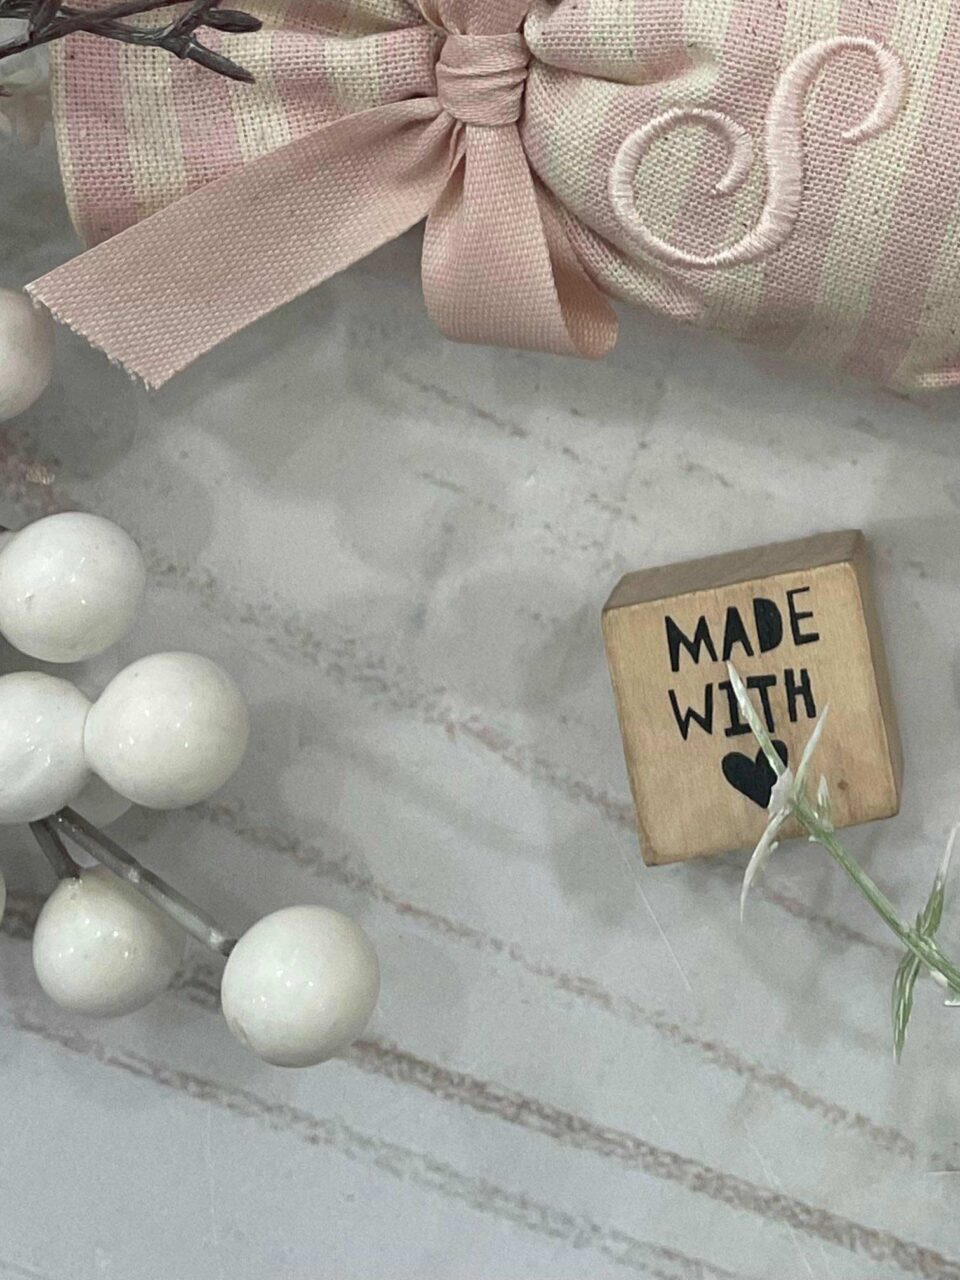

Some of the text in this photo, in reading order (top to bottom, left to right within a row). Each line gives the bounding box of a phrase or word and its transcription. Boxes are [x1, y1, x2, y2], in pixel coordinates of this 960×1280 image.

[608, 35, 906, 267] S
[664, 586, 820, 673] MADE
[667, 667, 817, 741] WITH
